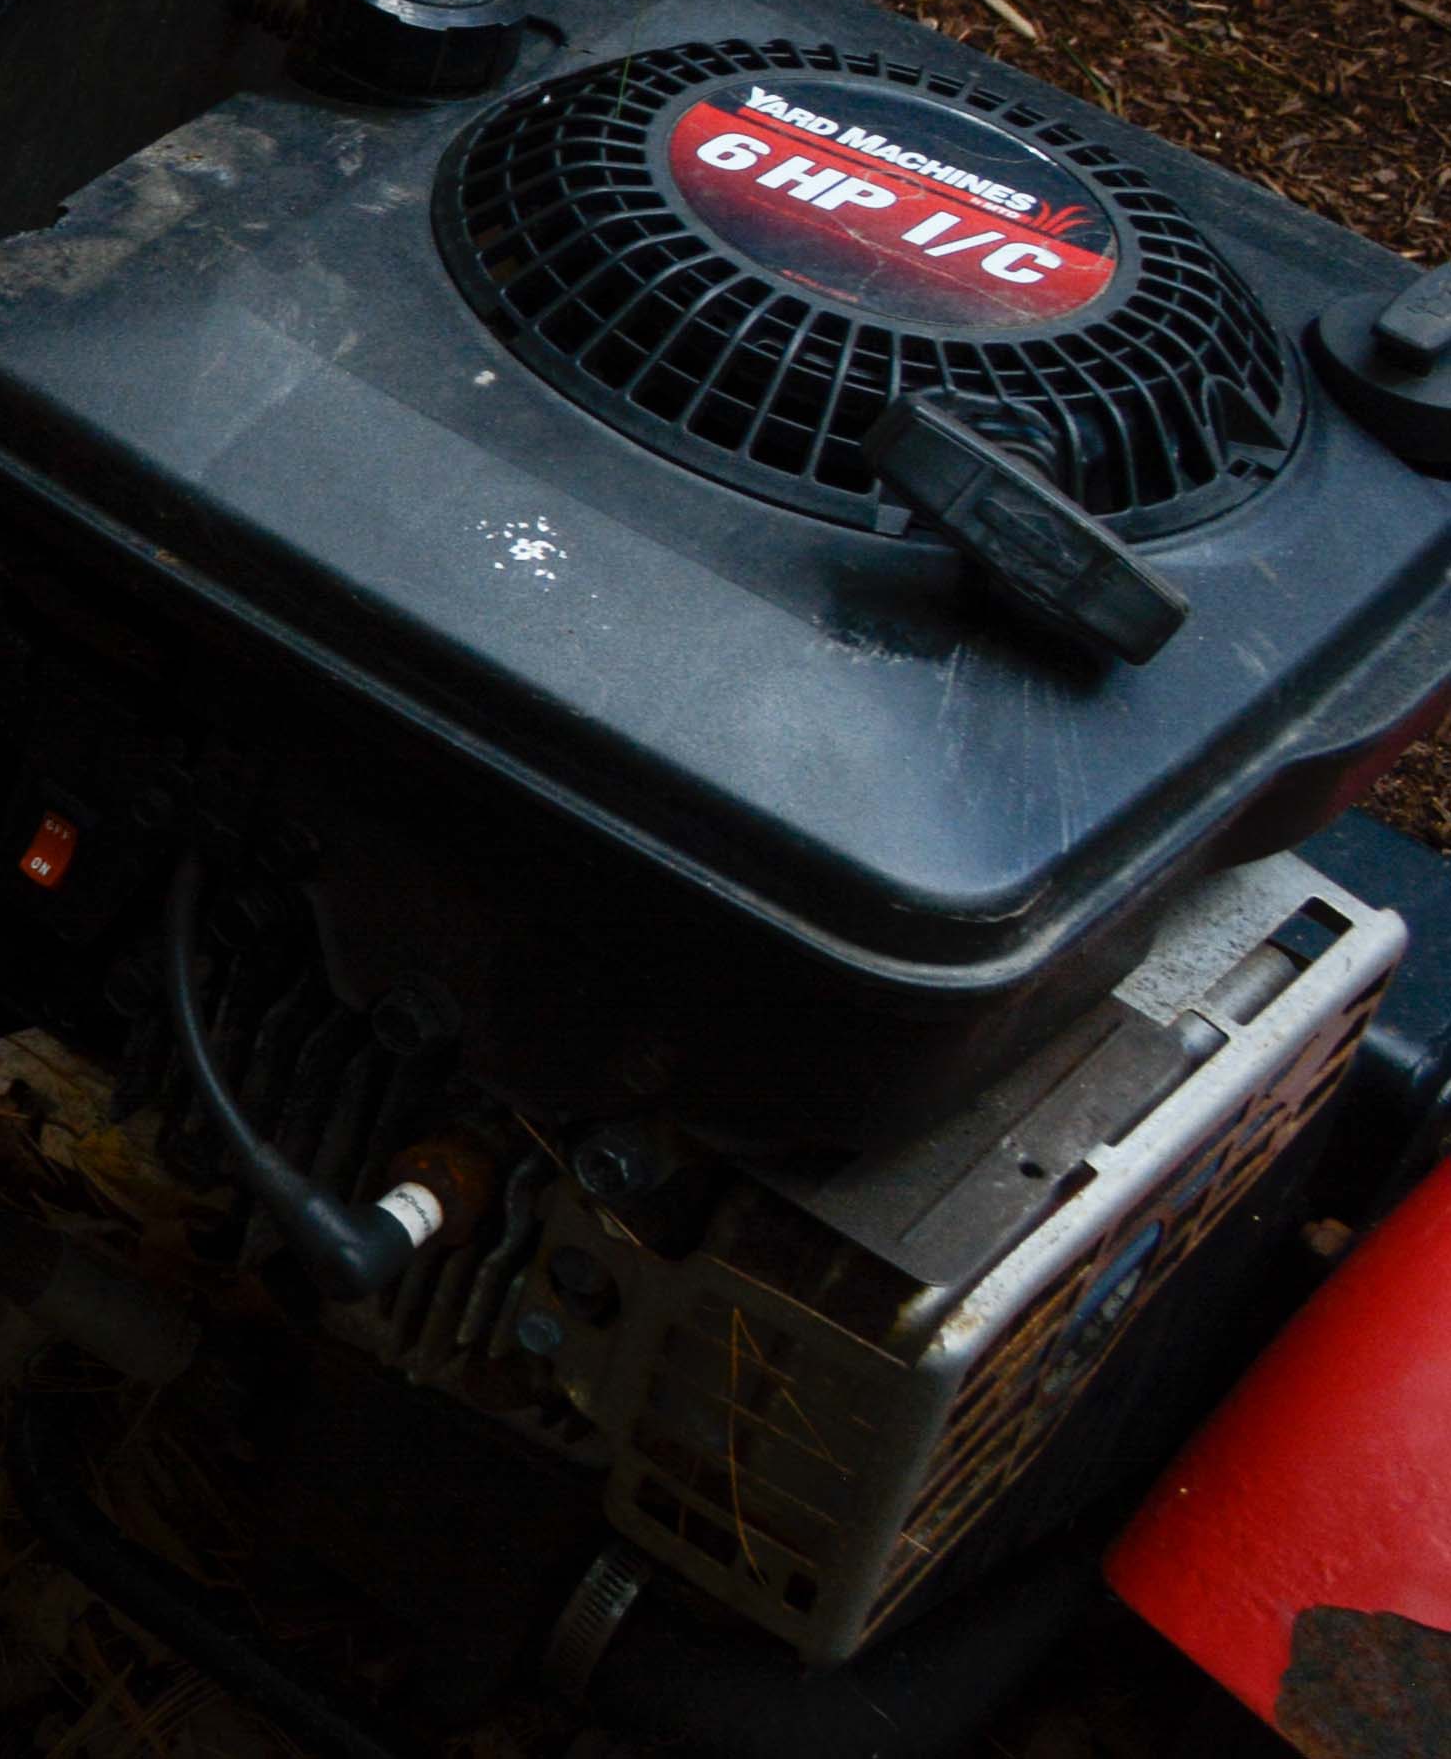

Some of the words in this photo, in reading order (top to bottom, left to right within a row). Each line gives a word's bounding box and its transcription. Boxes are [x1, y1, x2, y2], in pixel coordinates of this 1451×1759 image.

[695, 132, 771, 172] 6
[755, 154, 898, 211] HP
[745, 86, 840, 137] YARD
[836, 126, 1039, 212] MACHINES
[30, 856, 52, 877] ON
